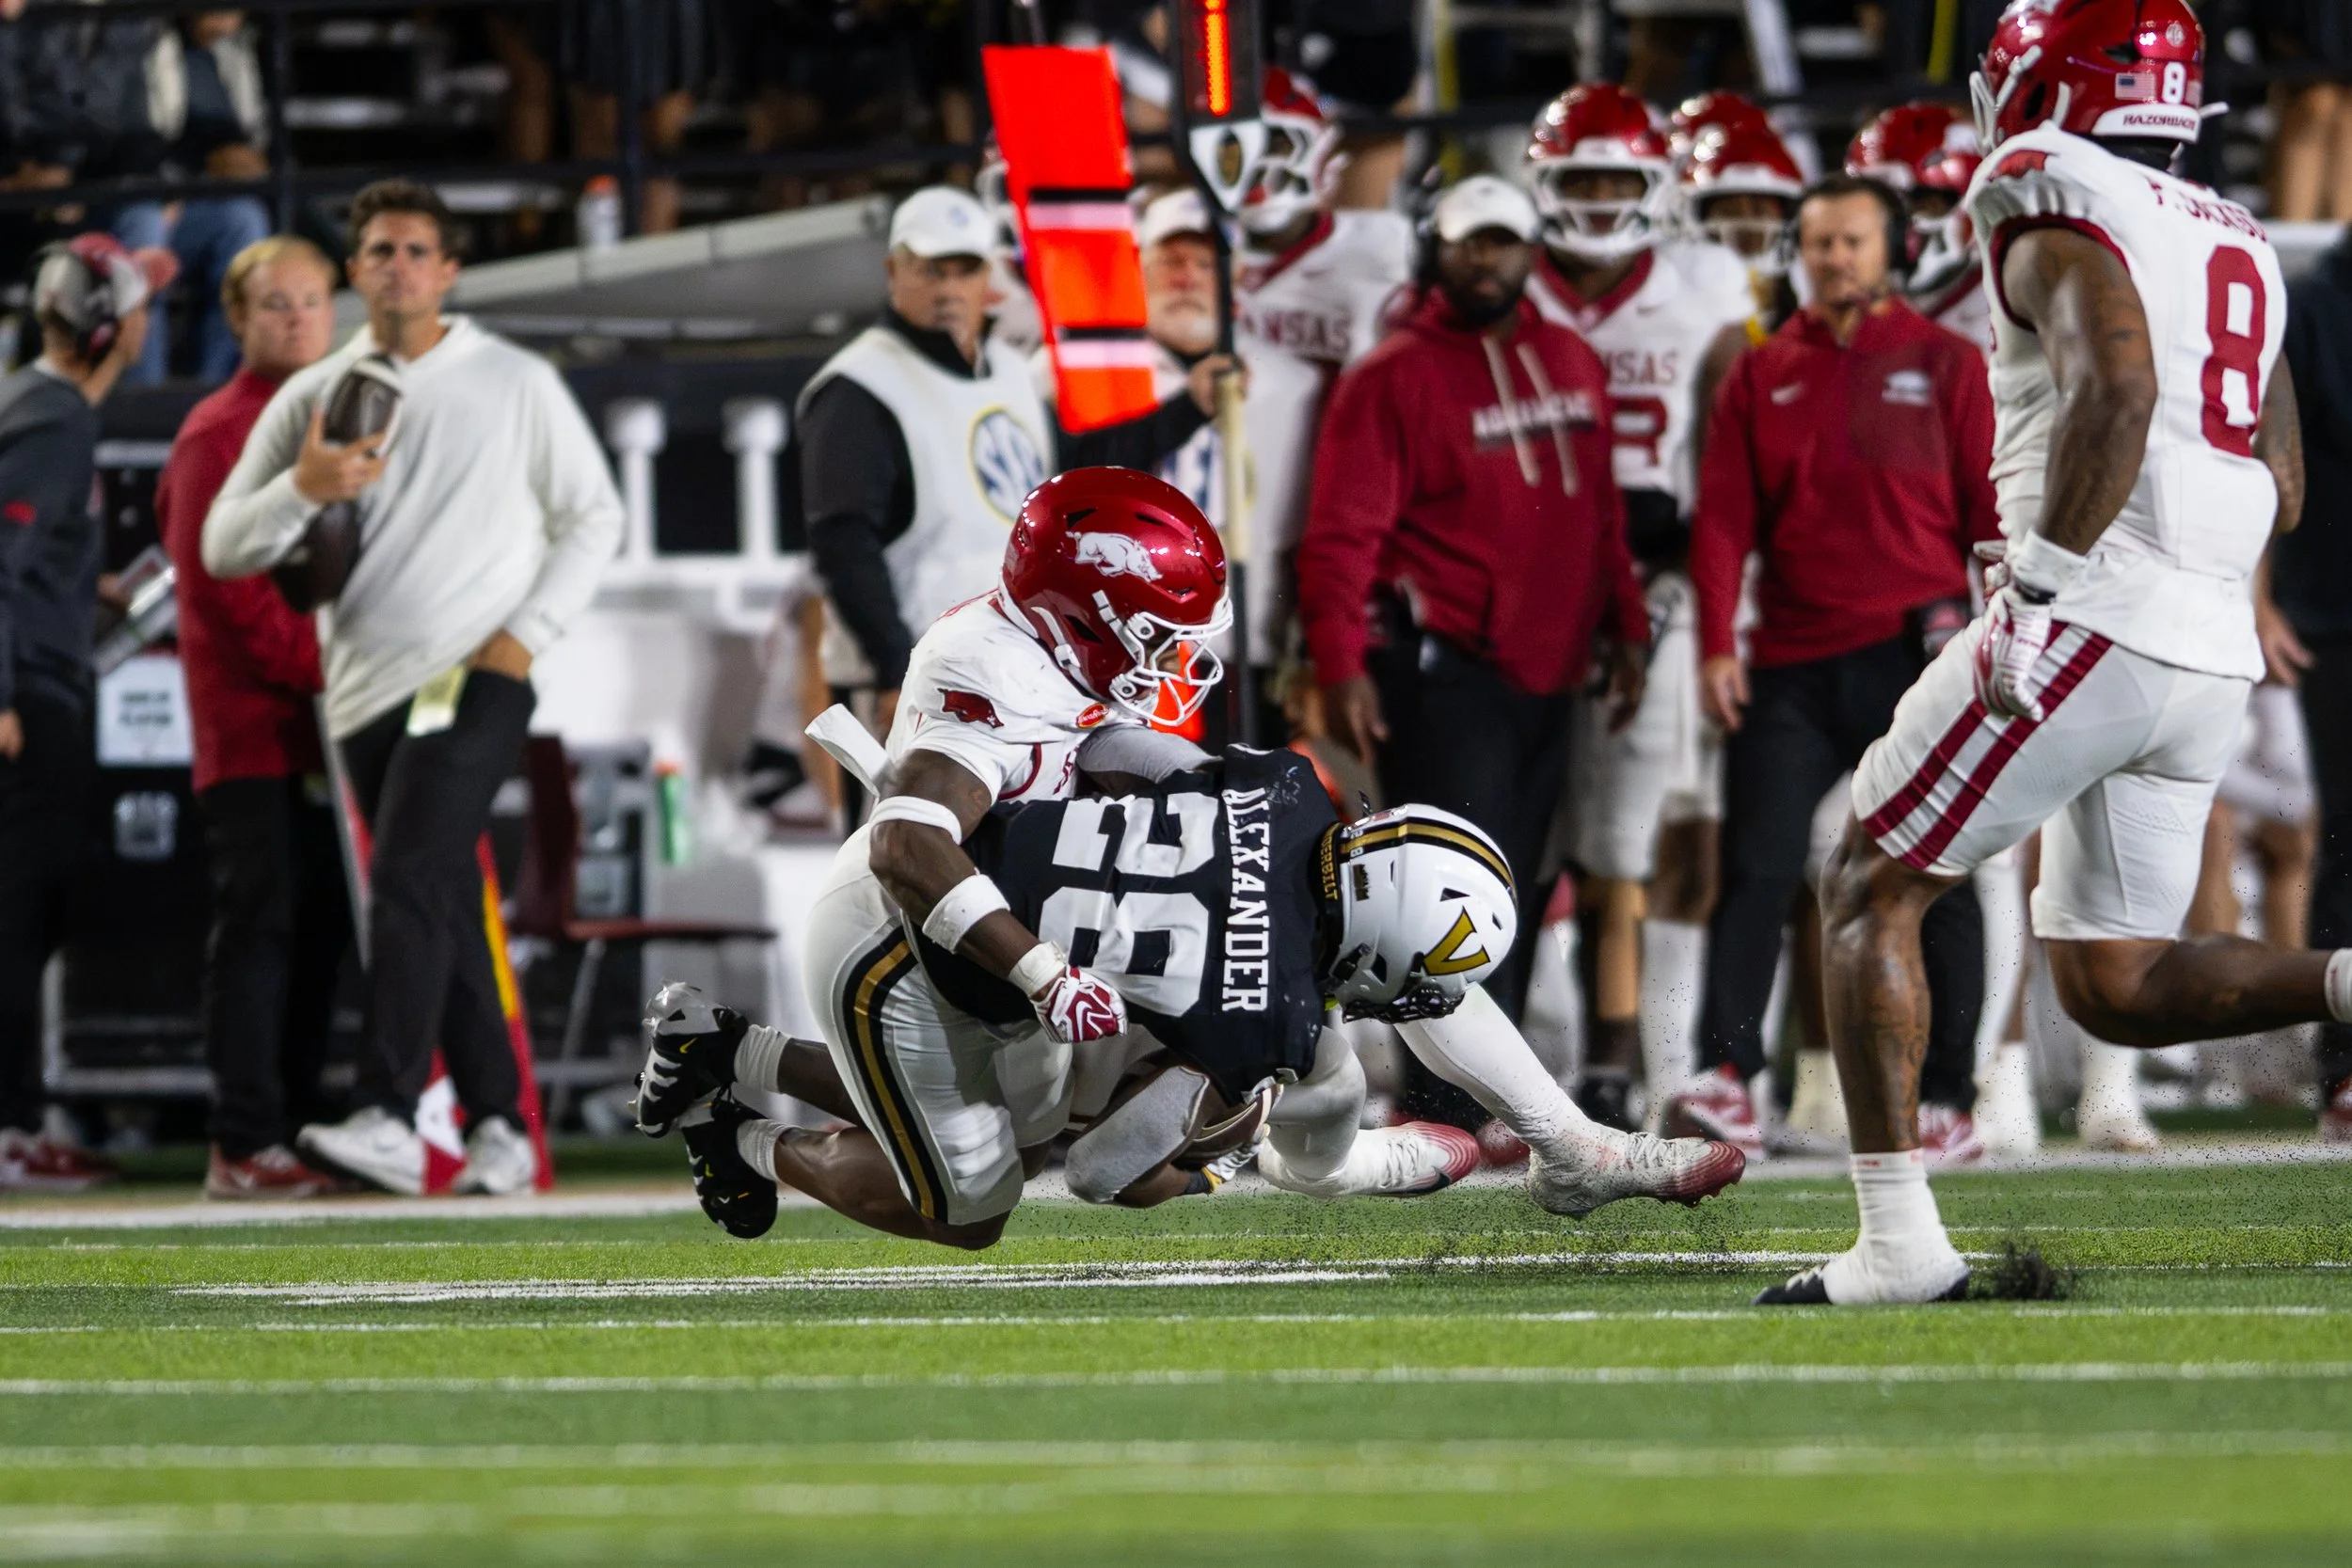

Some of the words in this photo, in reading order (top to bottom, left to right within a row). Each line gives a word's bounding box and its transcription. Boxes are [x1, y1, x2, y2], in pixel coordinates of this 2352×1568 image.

[2162, 61, 2186, 104] 8
[2201, 245, 2266, 459] 8
[1039, 791, 1219, 1018] 28
[1220, 787, 1270, 1012] ALEXANDER
[1422, 904, 1491, 977] V
